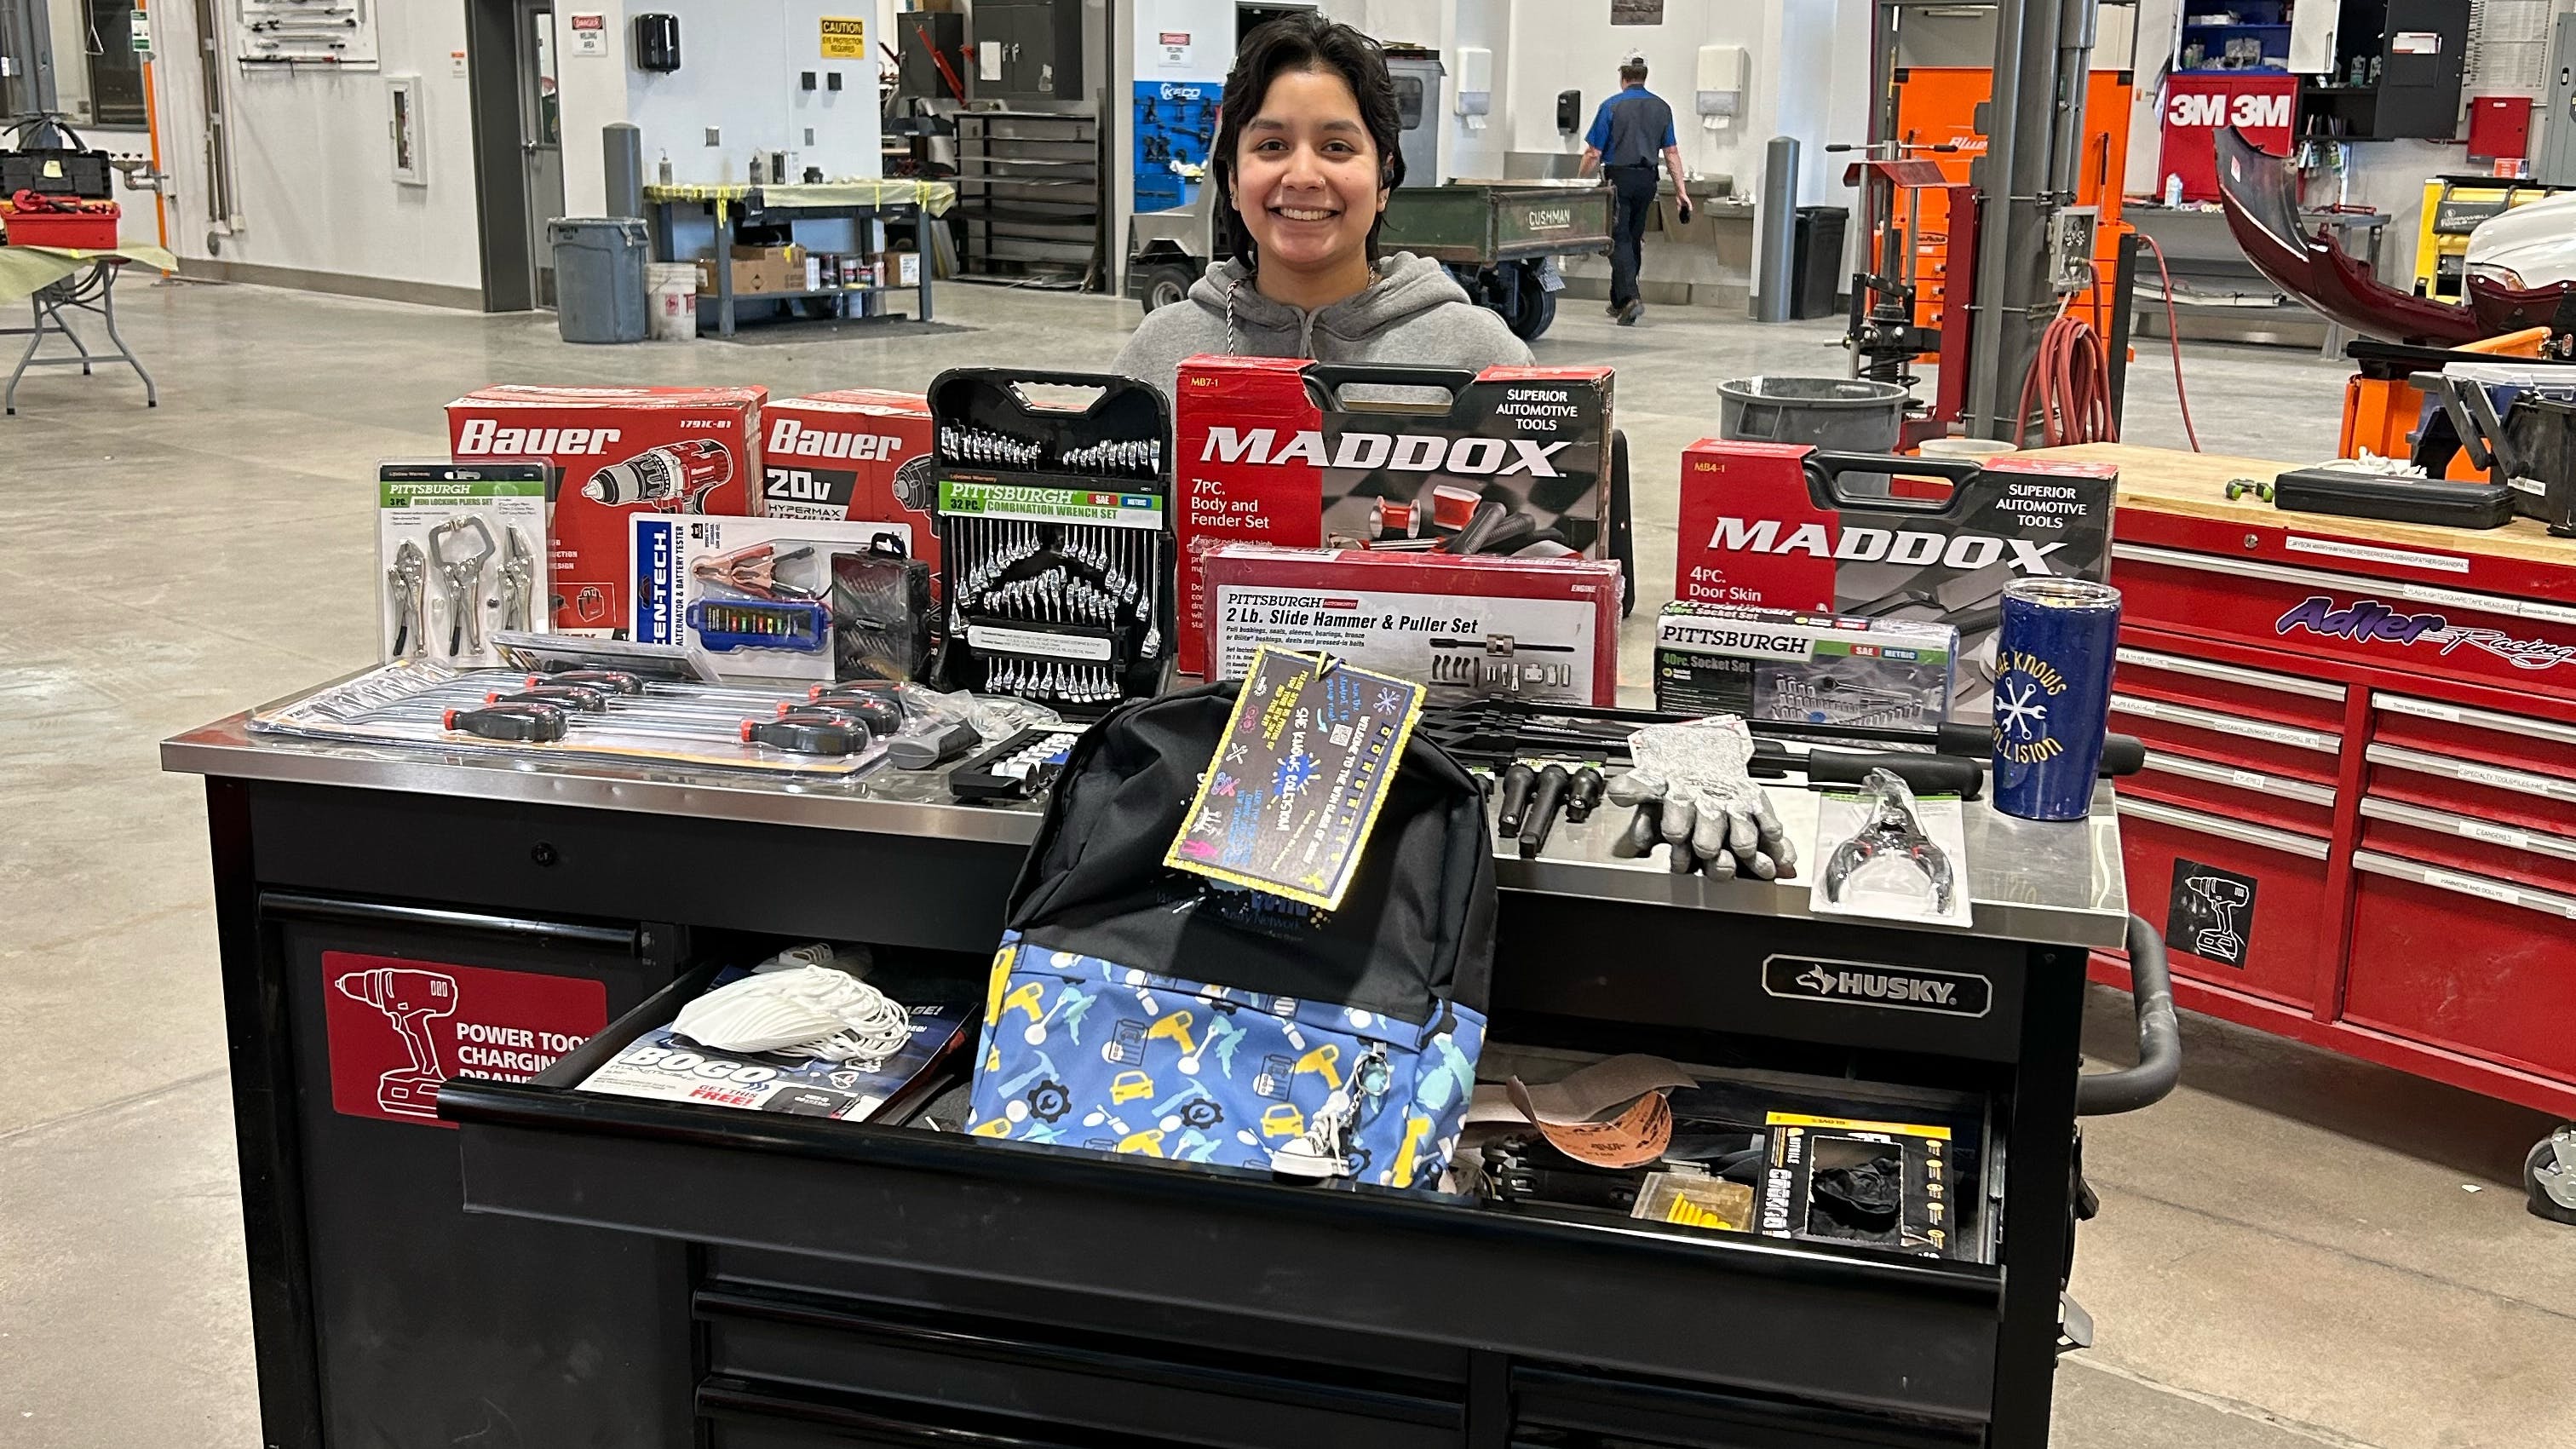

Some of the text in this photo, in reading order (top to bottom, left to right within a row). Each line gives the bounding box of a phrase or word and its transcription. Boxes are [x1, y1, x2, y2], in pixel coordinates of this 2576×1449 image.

[823, 21, 862, 33] CAUTION
[2169, 95, 2291, 127] 3M 3M
[1529, 209, 1570, 226] CUSHMAN
[1190, 377, 1219, 388] MB7-1
[1506, 388, 1568, 403] SUPERIOR
[1495, 404, 1578, 418] AUTOMOTIVE
[1515, 418, 1558, 431] TOOLS
[457, 419, 621, 455] Bauer
[768, 418, 903, 462] Bauer
[1199, 426, 1572, 477] MADDOX
[1694, 461, 1726, 474] MB4-1
[389, 484, 471, 495] PITTSBURGH
[767, 469, 831, 501] 20v
[950, 482, 1074, 504] PITTSBURGH
[1192, 479, 1226, 495] 7PC.
[2008, 483, 2077, 500] SUPERIOR
[396, 497, 408, 506] PC.
[482, 497, 493, 506] SET
[951, 498, 1118, 520] 32 PC. COMBINATION WRENCH SET
[1095, 495, 1110, 505] SAE
[1191, 497, 1258, 515] Body and
[1995, 498, 2087, 515] AUTOMOTIVE
[768, 503, 841, 517] HYPERMAX
[1191, 513, 1270, 529] Fender Set
[2017, 514, 2063, 529] TOOLS
[676, 526, 684, 554] TESTER
[1707, 516, 2068, 576] MADDOX
[676, 555, 684, 589] BATTERY
[1689, 566, 1727, 584] 4PC.
[1228, 593, 1321, 608] PITTSBURGH
[1689, 583, 1762, 602] Door Skin
[676, 598, 684, 646] ALTERNATOR
[1226, 608, 1478, 635] 2 Lb. Slide Hammer & Puller Set
[1661, 625, 1808, 654] PITTSBURGH
[2275, 596, 2446, 645] Adler
[2441, 630, 2576, 670] Racing
[1855, 646, 1916, 659] SAE METRIC
[1690, 656, 1730, 671] Socket
[1731, 658, 1751, 673] Set
[1276, 707, 1308, 831] SHE KNOWS COLLISION
[1838, 971, 1955, 1004] HUSKY
[457, 1021, 591, 1052] POWER TOO
[625, 1046, 779, 1084] BOGO
[687, 1088, 752, 1107] FREE!
[699, 1084, 758, 1099] GET THIS
